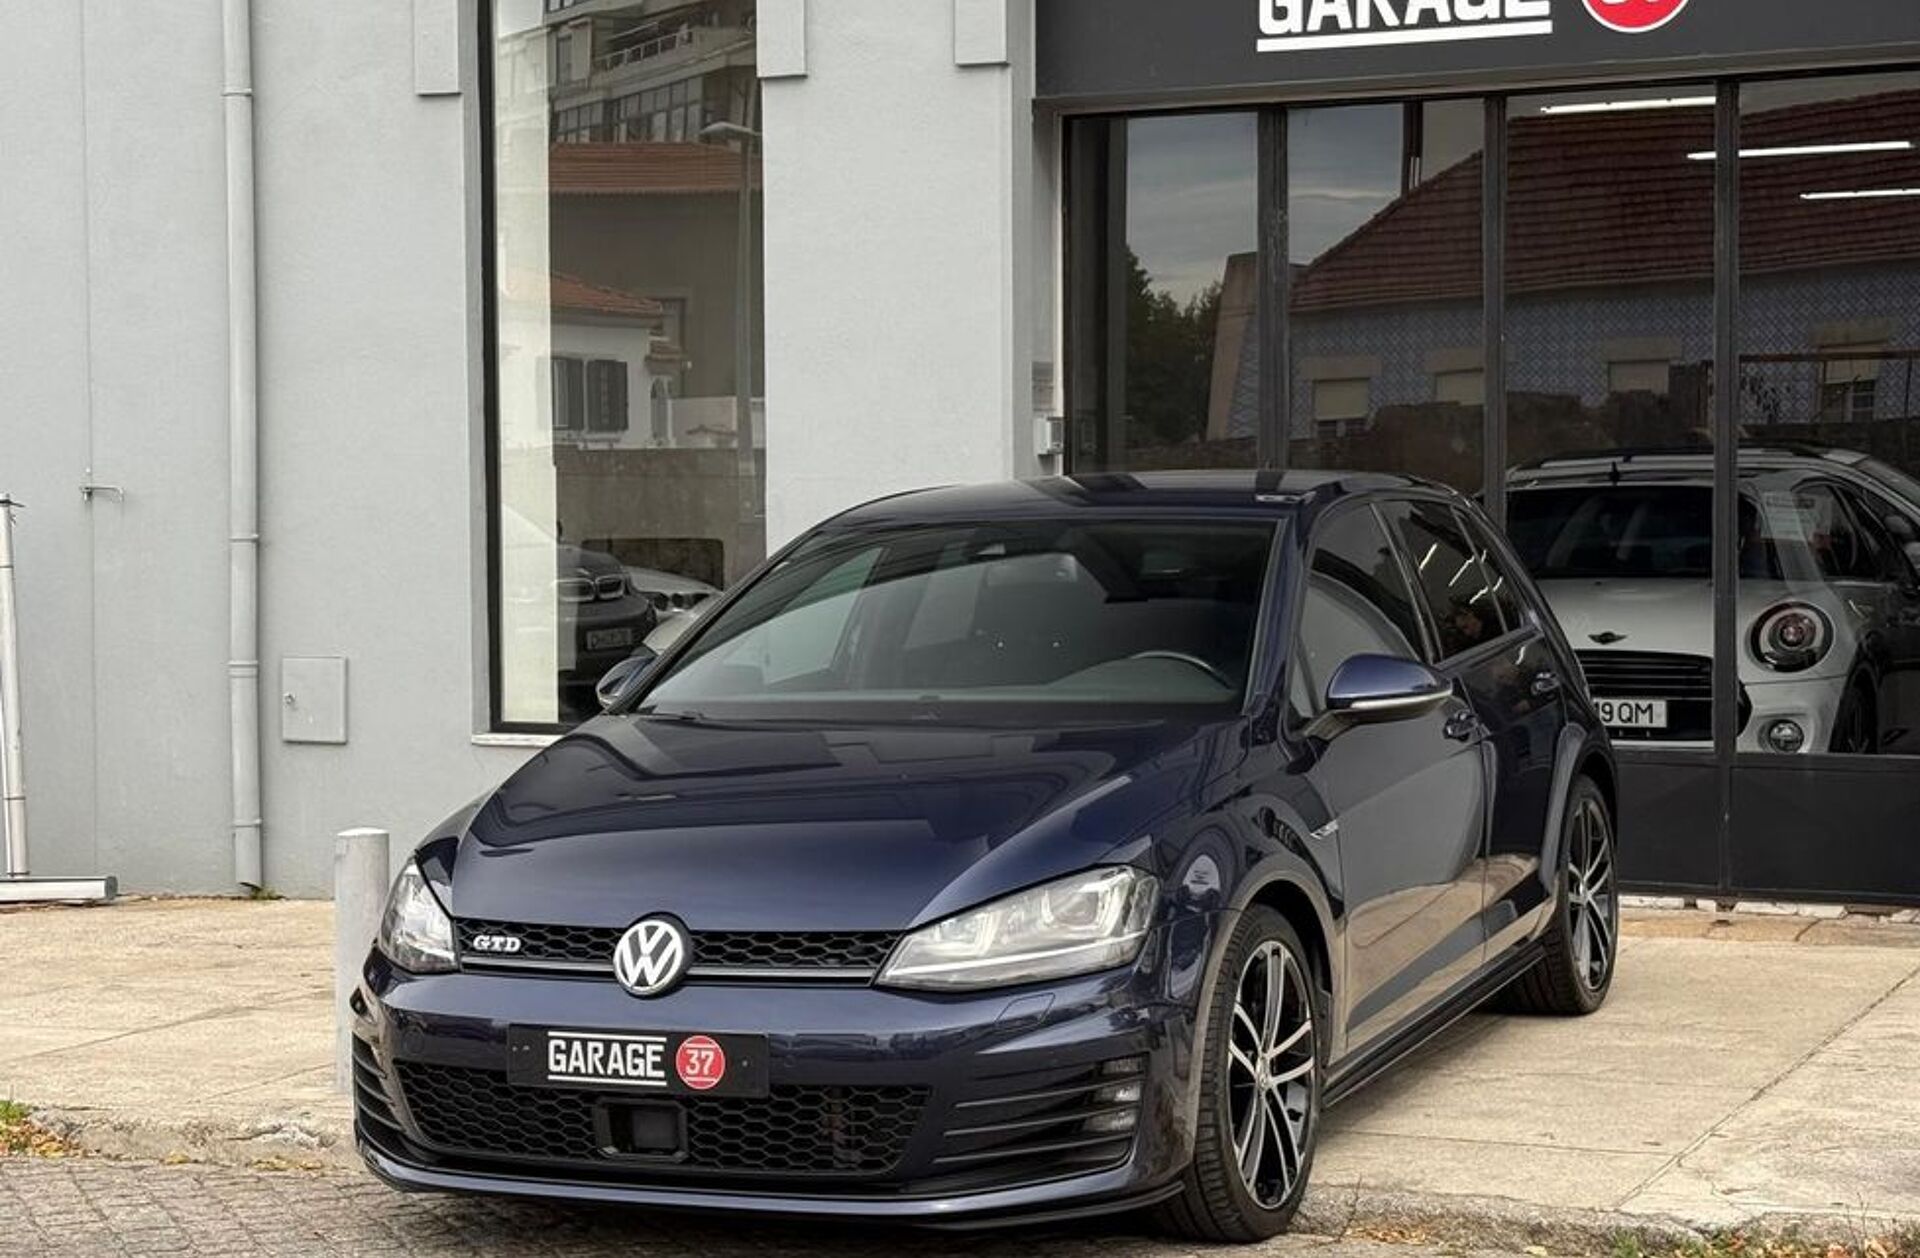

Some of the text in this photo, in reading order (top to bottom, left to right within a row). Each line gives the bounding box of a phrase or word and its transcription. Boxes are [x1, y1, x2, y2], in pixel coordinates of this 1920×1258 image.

[473, 934, 521, 952] GTD
[548, 1039, 715, 1078] GARAGE 37
